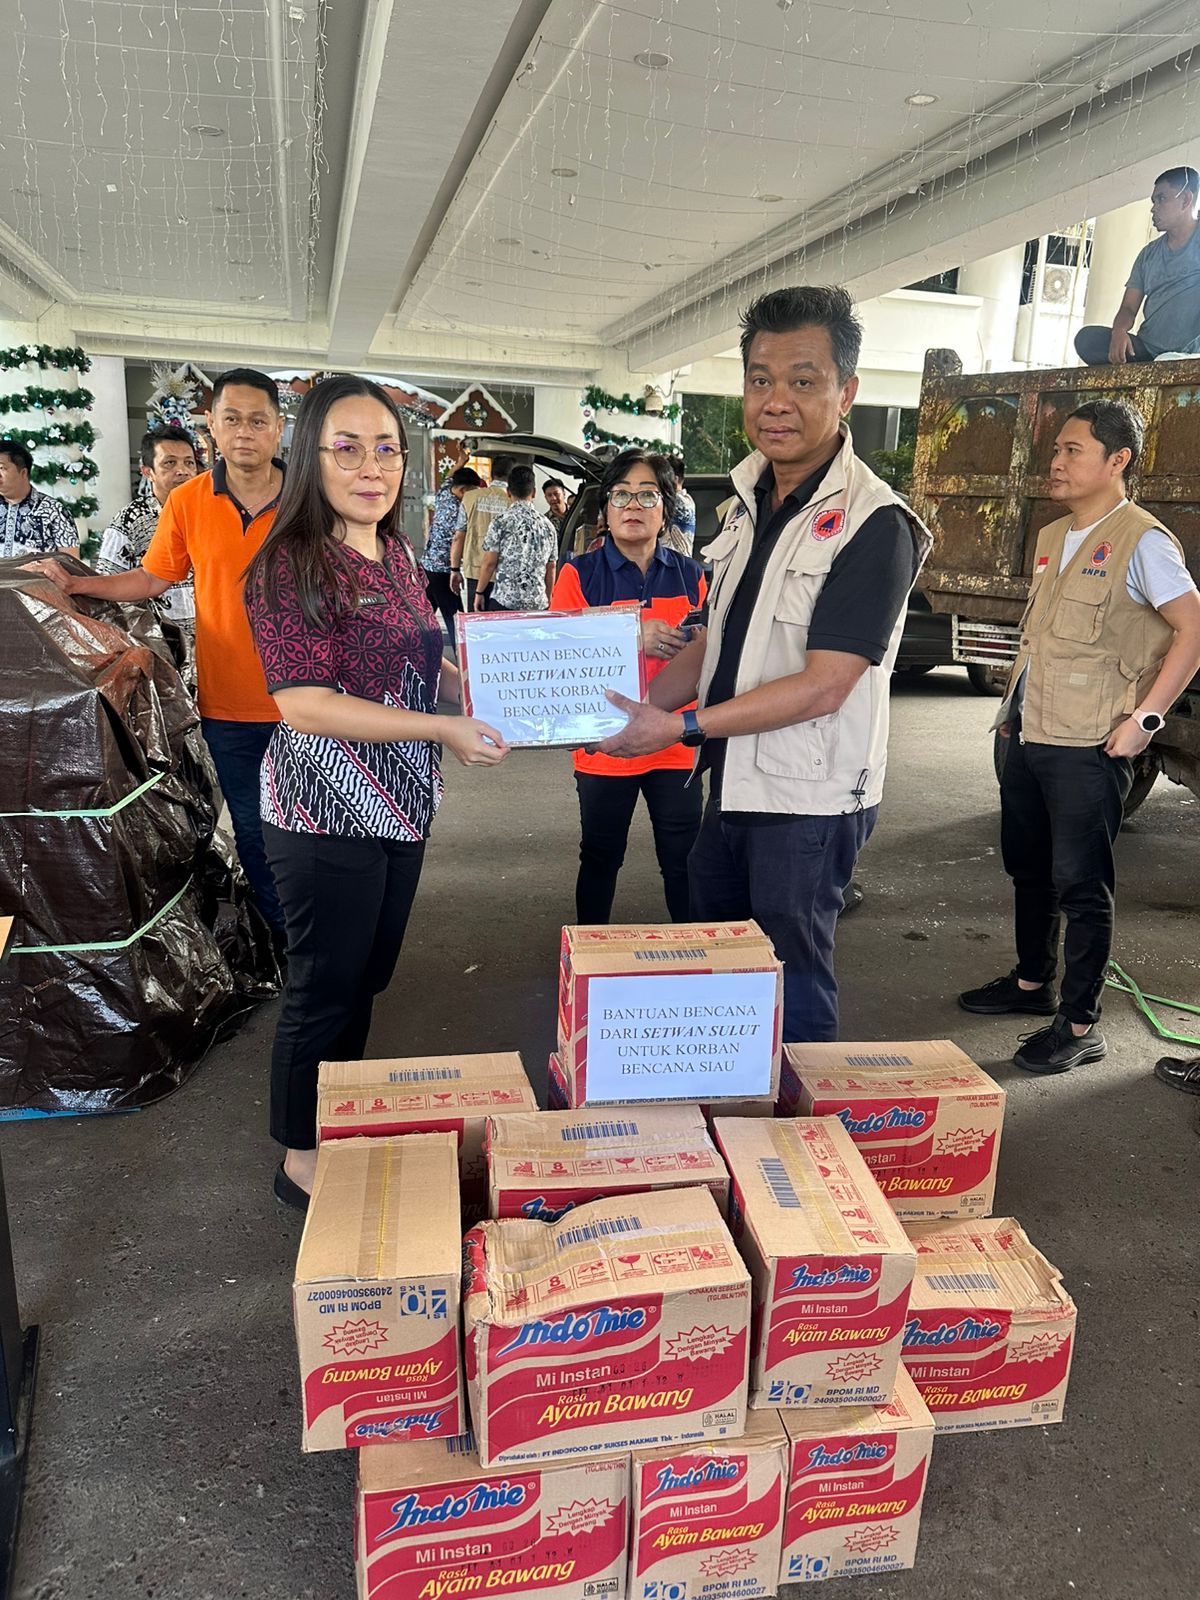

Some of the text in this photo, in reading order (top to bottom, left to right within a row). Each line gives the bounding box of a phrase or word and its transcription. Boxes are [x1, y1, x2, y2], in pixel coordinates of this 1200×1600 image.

[1082, 568, 1106, 577] BNPB
[481, 646, 622, 664] BANTUAN BENCANA
[481, 665, 626, 683] DARI SETWAN SULUT
[498, 684, 609, 700] UNTUK KORBAN
[503, 702, 607, 718] BENCANA SIAU
[603, 1005, 757, 1020] BANTUAN BENCANA
[600, 1024, 760, 1040] DARI SETWAN SULUT
[618, 1043, 740, 1057] UNTUK KORBAN
[622, 1061, 735, 1075] BENCANA SIAU
[863, 1153, 896, 1165] nstan
[888, 1176, 954, 1193] Bawang
[308, 1287, 392, 1301] 240935004600027
[319, 1300, 382, 1313] BPOM RI MD
[801, 1304, 848, 1314] Mi Instan
[687, 1333, 715, 1344] Lengkap
[782, 1326, 891, 1346] Ayam Bawang
[677, 1337, 726, 1352] Dengan Minyak
[690, 1346, 716, 1356] Bawang
[322, 1358, 443, 1384] Ayam Bawang
[536, 1373, 557, 1388] Mi
[560, 1365, 611, 1384] Instan
[911, 1366, 970, 1378] Mi Instan
[826, 1387, 854, 1395] BPOM
[924, 1385, 948, 1393] Rasa
[959, 1383, 1028, 1404] Bawang
[376, 1391, 427, 1402] Mi Instan
[557, 1393, 587, 1405] Rasa
[814, 1395, 887, 1404] 240935004600027
[537, 1387, 694, 1427] Ayam Bawang
[552, 1446, 588, 1456] INDOFOOD
[604, 1440, 628, 1449] SUKSES
[630, 1437, 659, 1445] MAKMUR
[819, 1482, 864, 1493] Mi Instan
[374, 1481, 526, 1541] Indomie
[567, 1506, 596, 1519] Lengkap
[670, 1504, 717, 1518] Mi Instan
[800, 1500, 907, 1524] Ayam Bawang
[558, 1509, 606, 1528] Dengan Minyak
[570, 1518, 597, 1530] Bawang
[652, 1523, 764, 1550] Ayam Bawang
[667, 1526, 688, 1534] Rasa
[415, 1548, 436, 1564] Mi
[440, 1542, 492, 1561] Instan
[845, 1558, 872, 1566] BPOM
[418, 1560, 576, 1600] Ayam Bawang
[438, 1568, 468, 1580] Rasa
[702, 1582, 730, 1592] BPOM
[743, 1578, 757, 1586] MD
